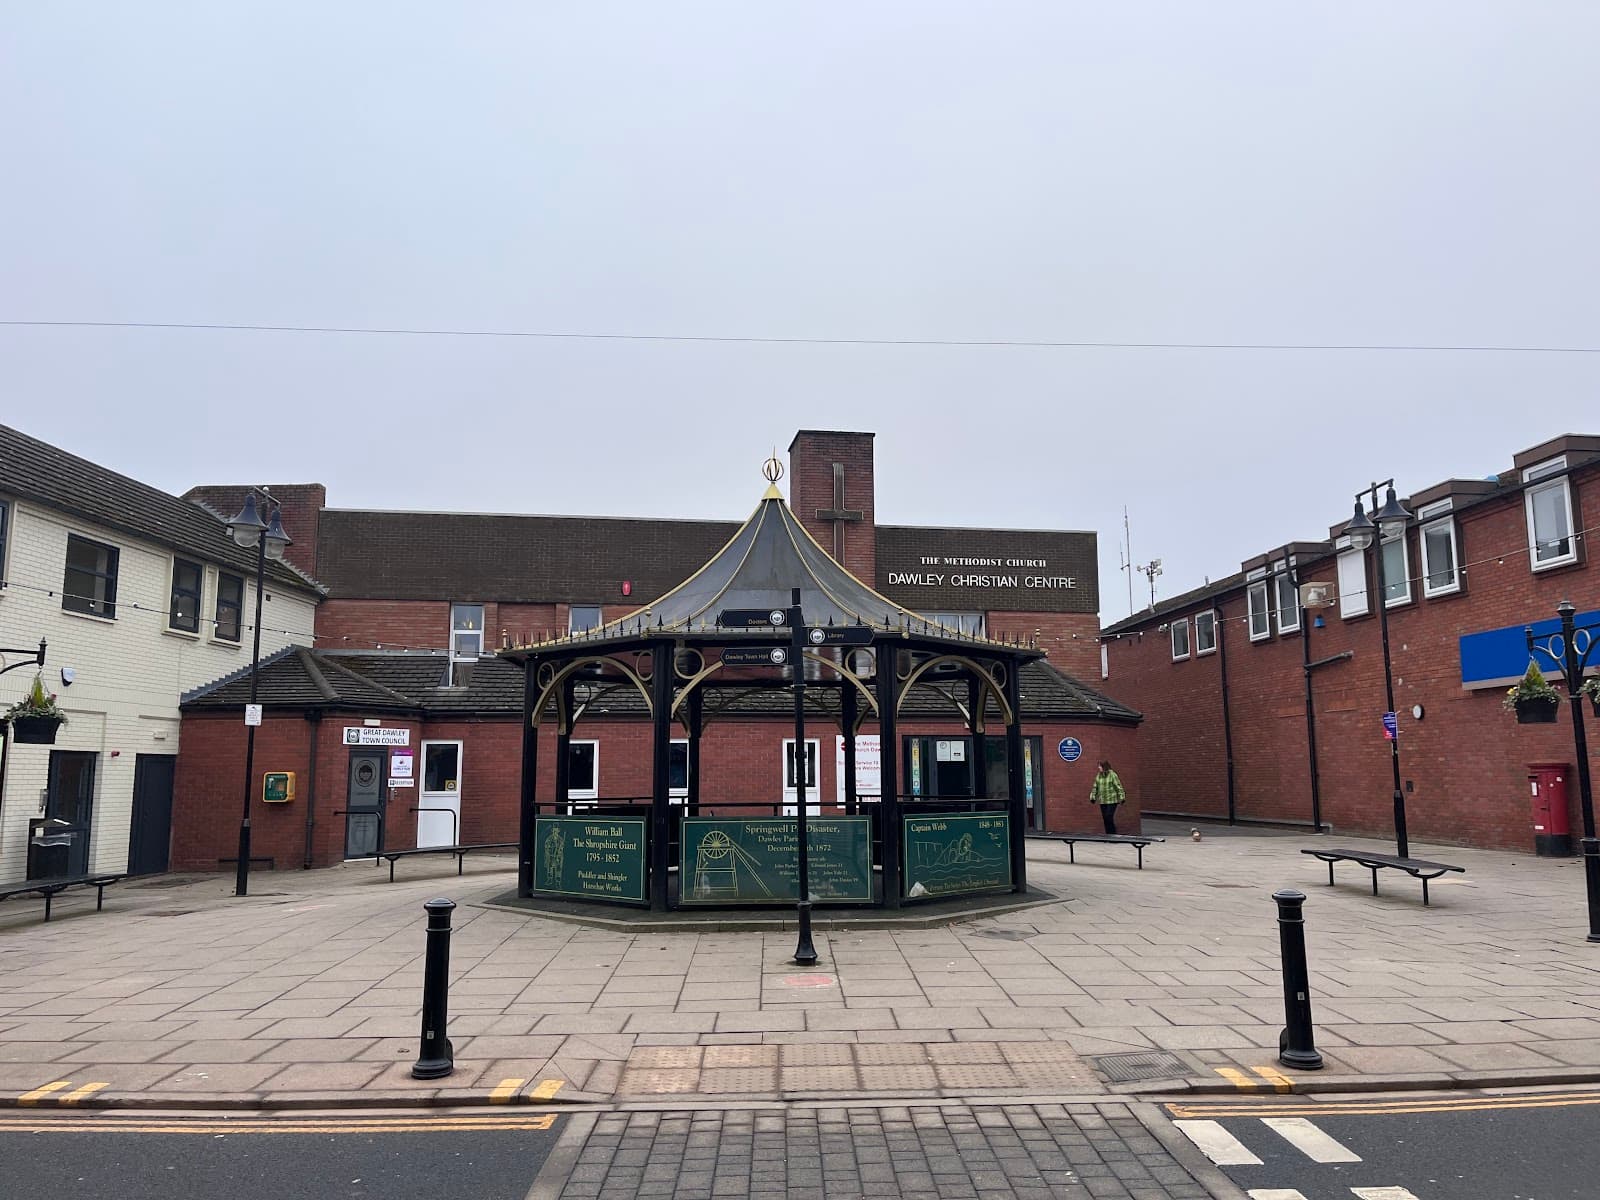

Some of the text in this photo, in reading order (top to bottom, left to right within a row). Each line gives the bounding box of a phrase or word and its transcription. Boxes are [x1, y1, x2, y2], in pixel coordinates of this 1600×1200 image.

[920, 557, 1046, 567] THE METHODIST CHURCH
[888, 573, 1076, 589] DAWLEY CHRISTIAN CENTRE
[383, 729, 405, 737] DAWLEY
[585, 826, 622, 836] William Ball
[746, 824, 788, 835] Springwell
[911, 823, 931, 833] Captain
[931, 822, 947, 832] Webb
[573, 838, 636, 851] The Shropshire Giant
[816, 844, 831, 852] 1872
[586, 853, 600, 862] 1795
[605, 854, 620, 863] 1852
[597, 872, 607, 880] and
[606, 882, 621, 891] Works
